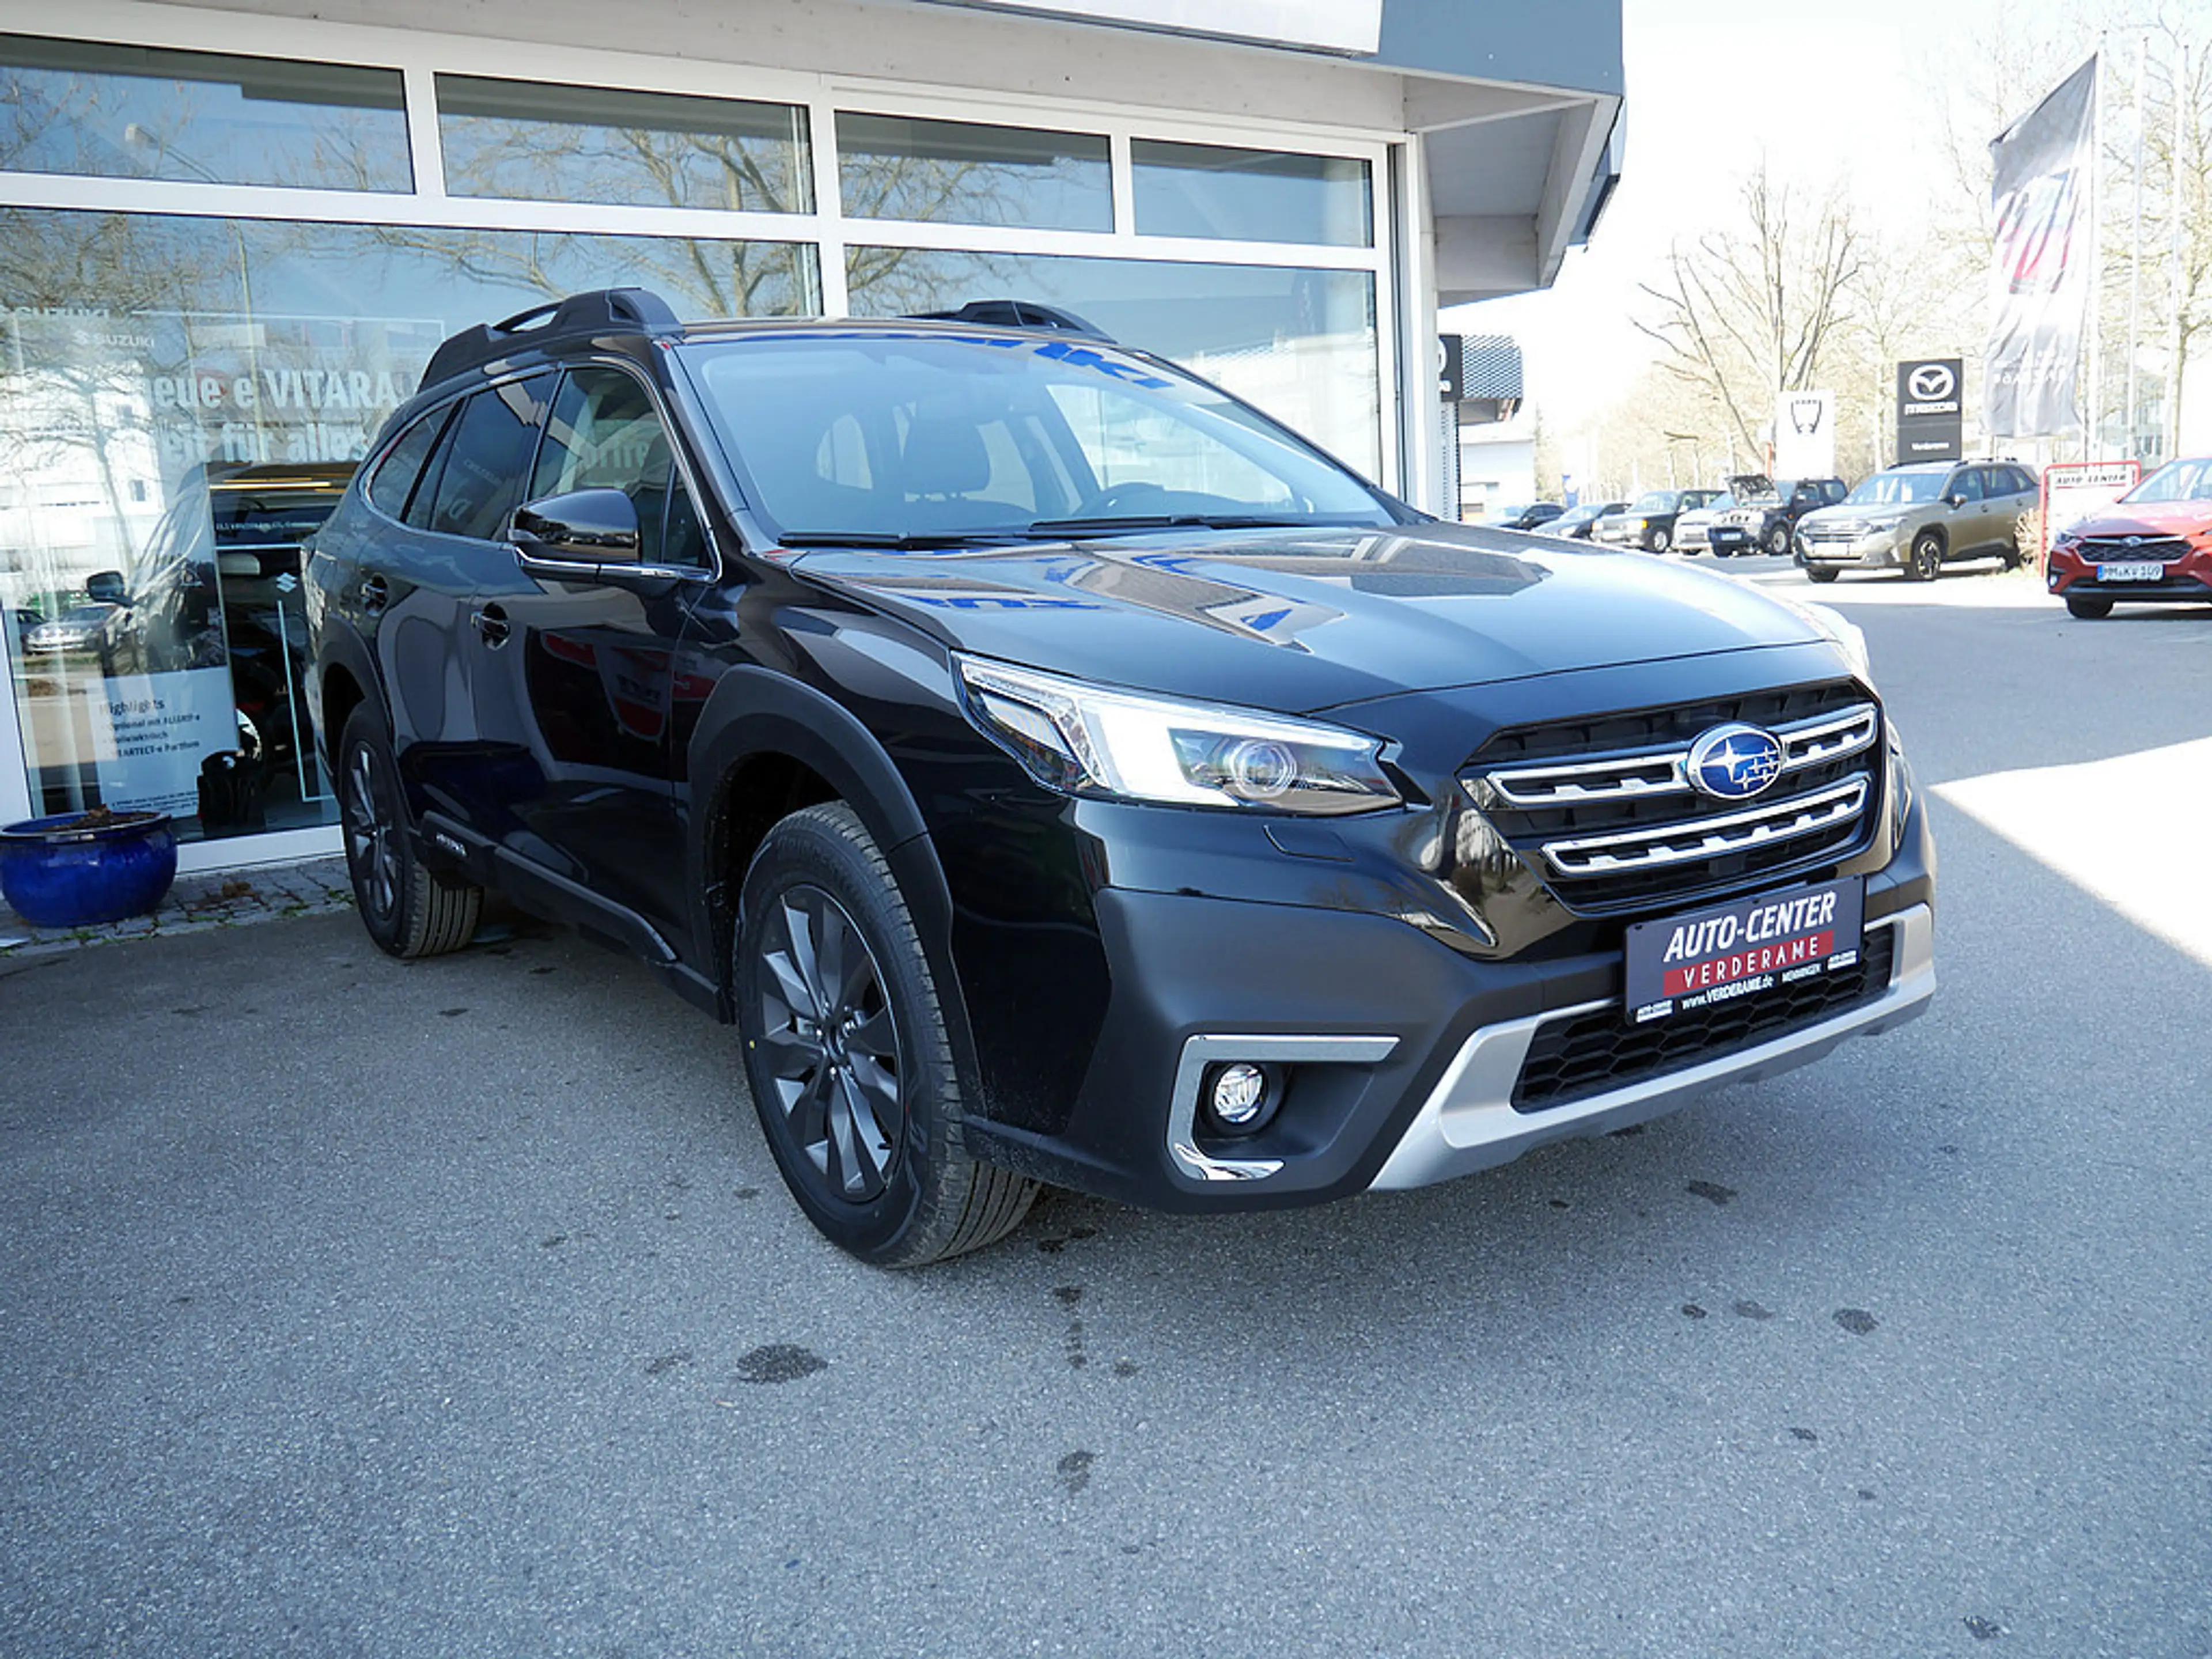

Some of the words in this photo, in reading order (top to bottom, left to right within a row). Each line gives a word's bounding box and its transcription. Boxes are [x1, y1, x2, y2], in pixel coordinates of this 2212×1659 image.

[233, 376, 255, 408] e
[264, 369, 400, 408] VITARA
[1663, 889, 1838, 963] AUTO-CENTER
[1682, 935, 1819, 988] VERDERAME
[1681, 974, 1774, 1010] www.VERDERAME.de
